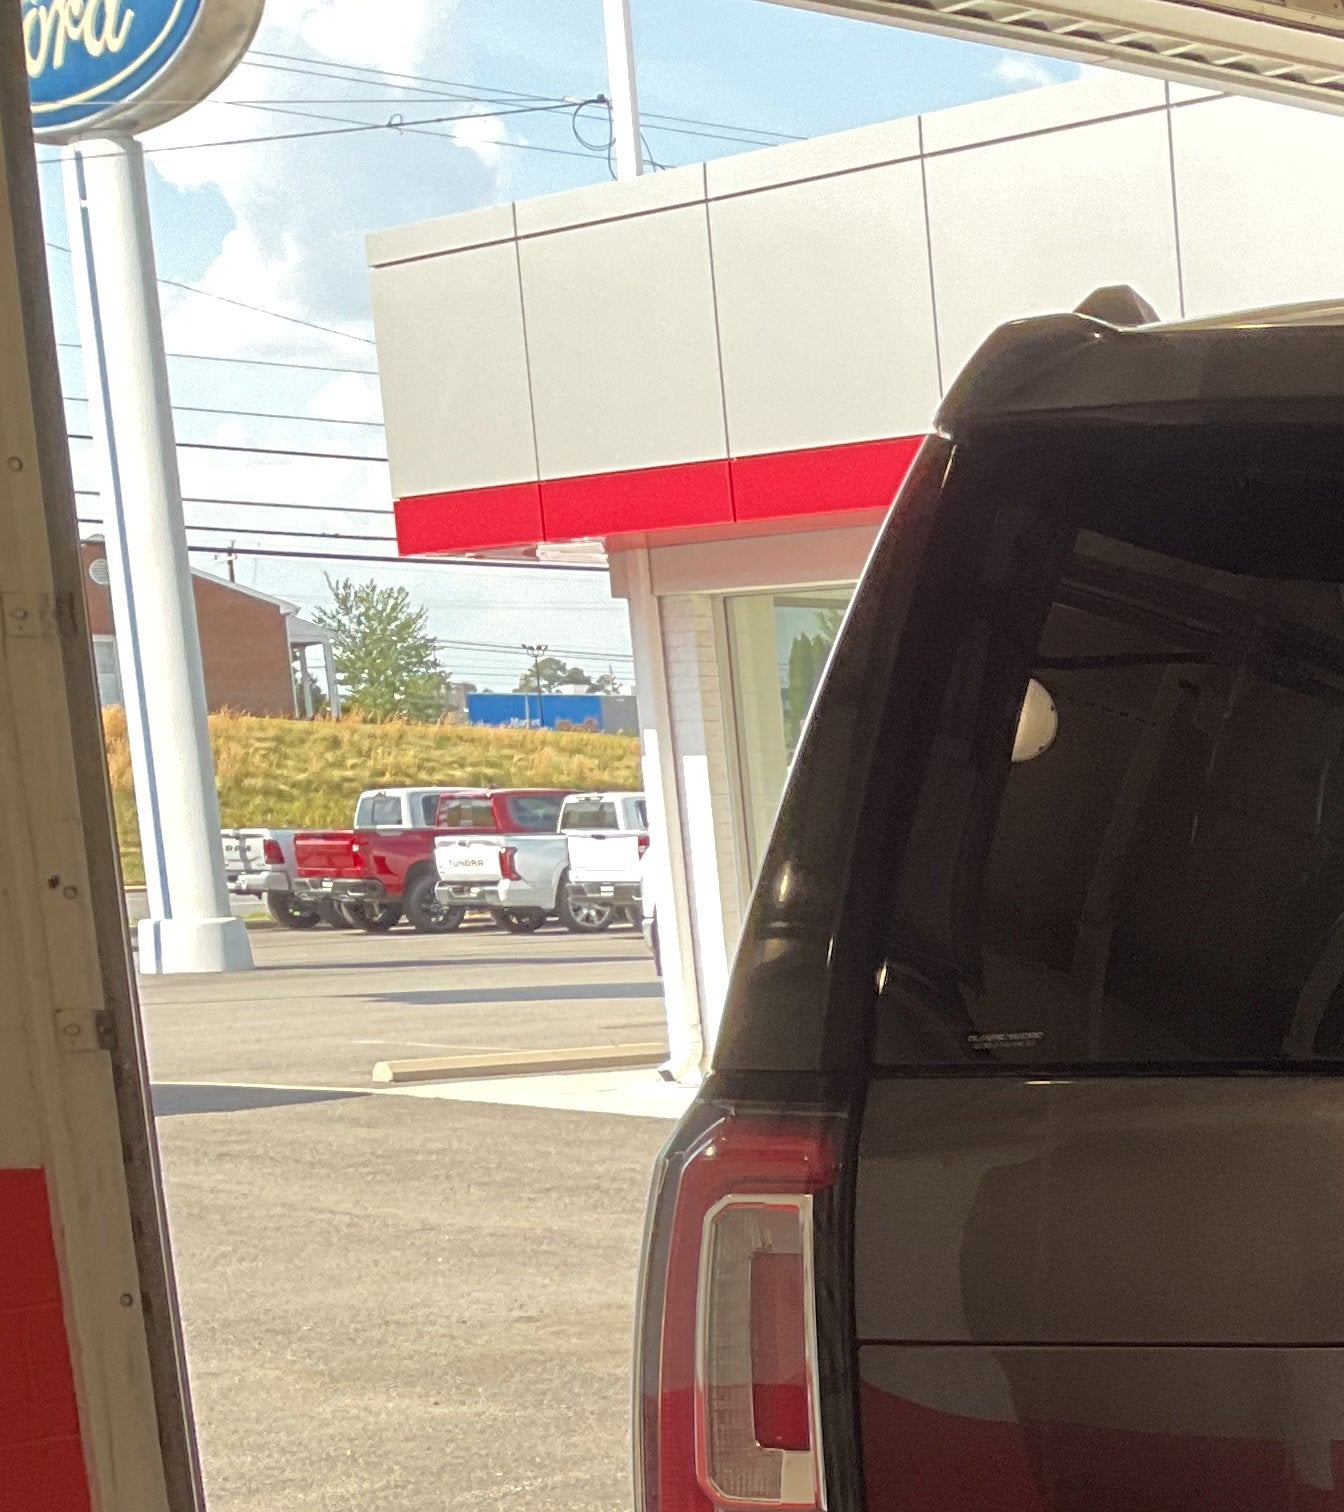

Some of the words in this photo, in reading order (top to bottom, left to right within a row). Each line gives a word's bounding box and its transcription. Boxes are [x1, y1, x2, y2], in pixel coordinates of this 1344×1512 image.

[22, 0, 134, 78] ord
[510, 717, 540, 727] Maret
[448, 859, 484, 867] TUNDRA
